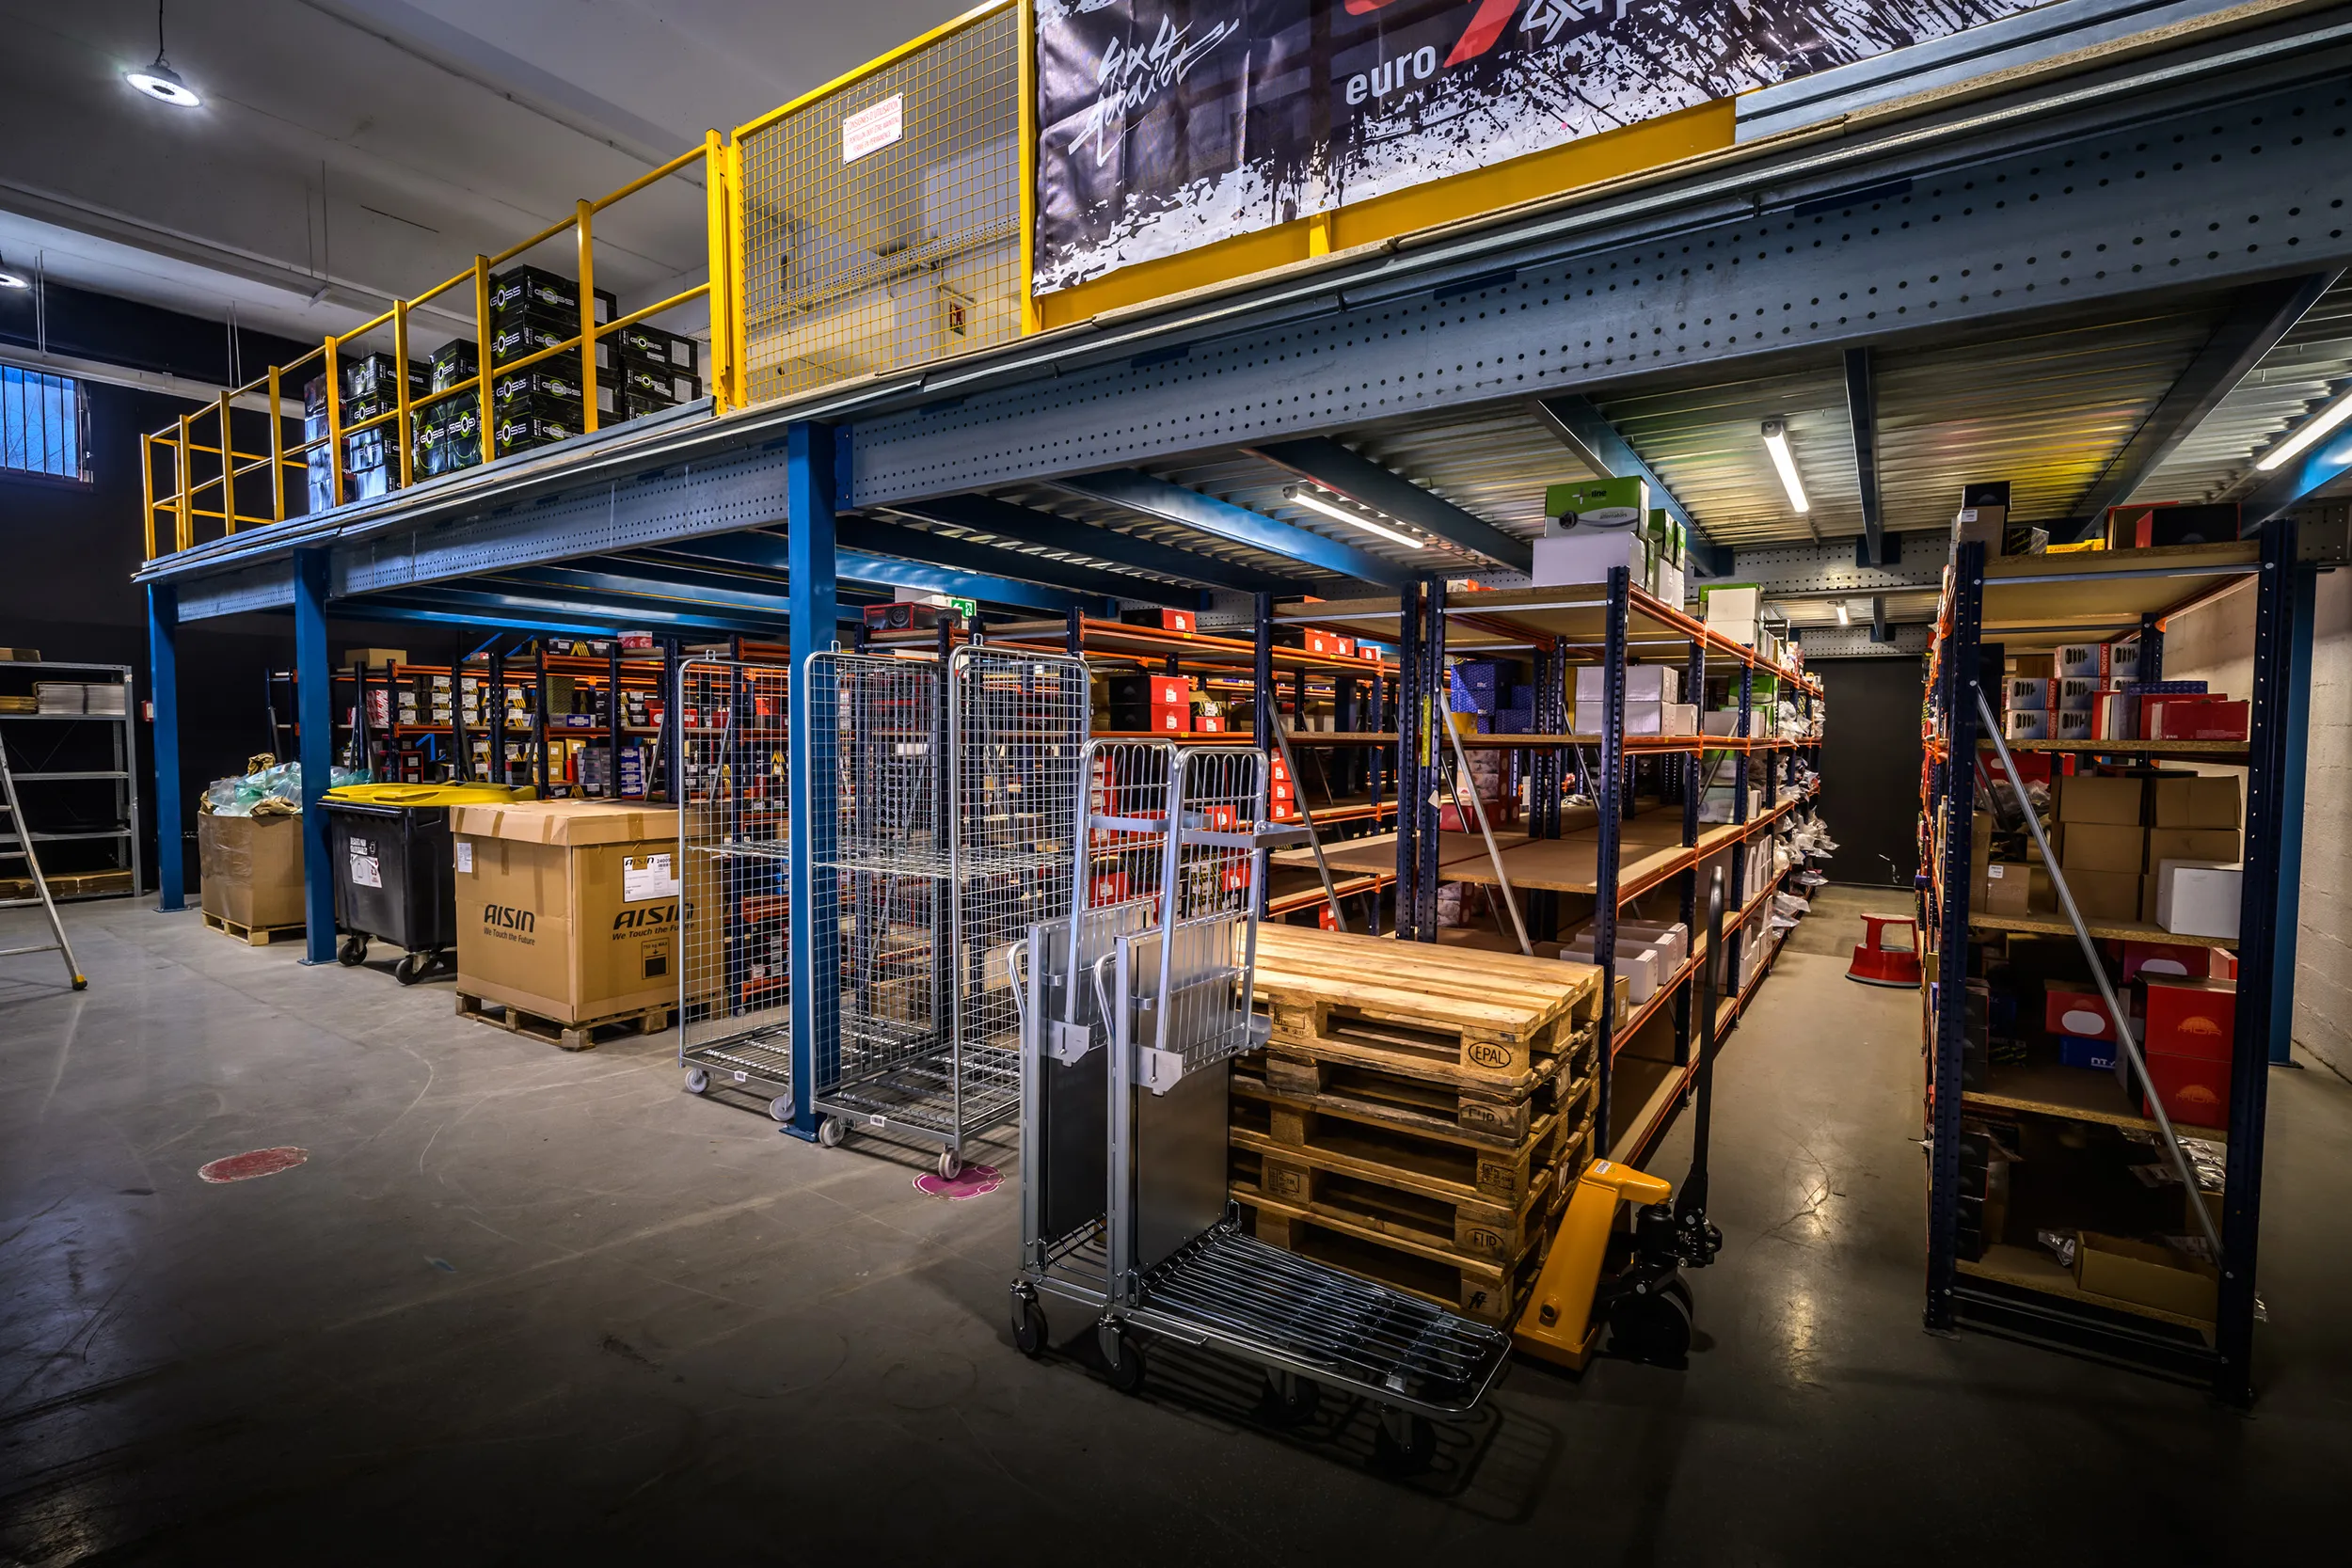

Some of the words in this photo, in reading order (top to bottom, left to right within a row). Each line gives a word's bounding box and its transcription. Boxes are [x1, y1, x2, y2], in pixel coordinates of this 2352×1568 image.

[1345, 45, 1437, 105] euro
[489, 285, 521, 307] GOSS
[490, 332, 520, 353] GOSS
[629, 337, 662, 351] GOSS
[355, 370, 374, 386] GOSS
[433, 363, 454, 380] GOSS
[496, 378, 527, 398] GOSS
[354, 404, 376, 420] GOSS
[449, 416, 476, 435] GOSS
[496, 423, 527, 442] GOSS
[420, 428, 444, 445] GOSS
[358, 443, 380, 457] GOSS
[1591, 489, 1607, 498] line
[2047, 678, 2056, 708] KARSONS
[625, 857, 655, 866] AISIN
[484, 903, 535, 933] AISIN
[612, 903, 694, 930] AISIN
[484, 927, 492, 936] We
[493, 928, 508, 940] Touch
[508, 933, 517, 942] the
[517, 934, 535, 946] Future
[628, 928, 653, 939] Touch
[655, 926, 668, 934] the
[1475, 1045, 1505, 1065] EPAL
